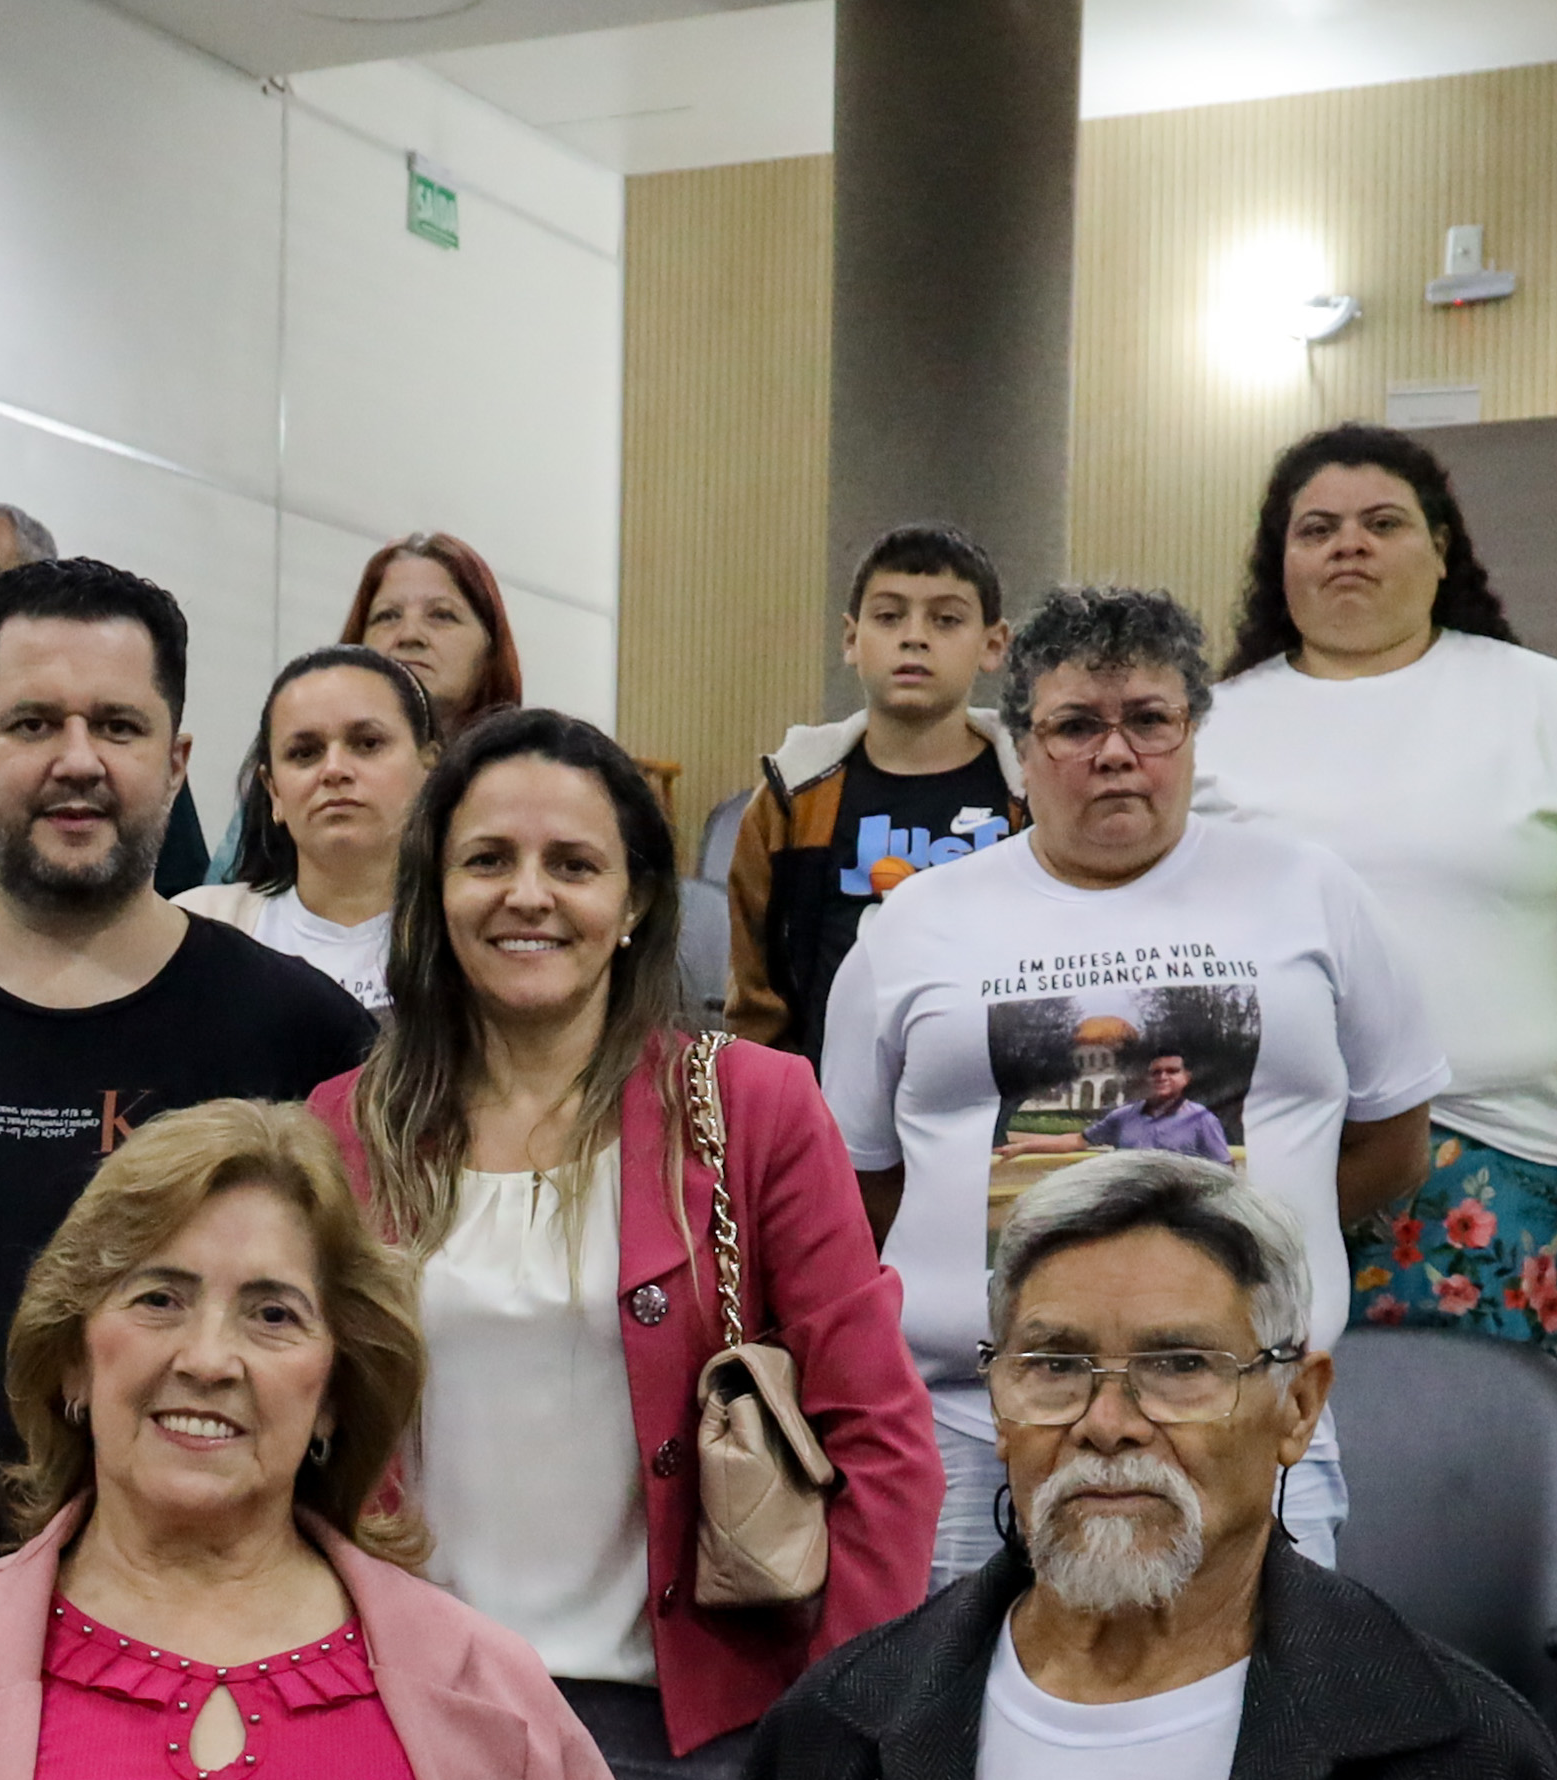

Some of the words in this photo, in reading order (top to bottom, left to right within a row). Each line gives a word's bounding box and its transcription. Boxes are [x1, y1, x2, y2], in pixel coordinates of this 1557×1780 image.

[1019, 957, 1045, 974] EM
[1055, 950, 1127, 971] DEFESA
[1136, 946, 1162, 963] DA
[1170, 942, 1217, 961] VIDA
[981, 976, 1028, 998] PELA
[1038, 963, 1157, 992] SEGURANÇA
[1166, 961, 1196, 979] NA
[1203, 960, 1259, 979] BR116
